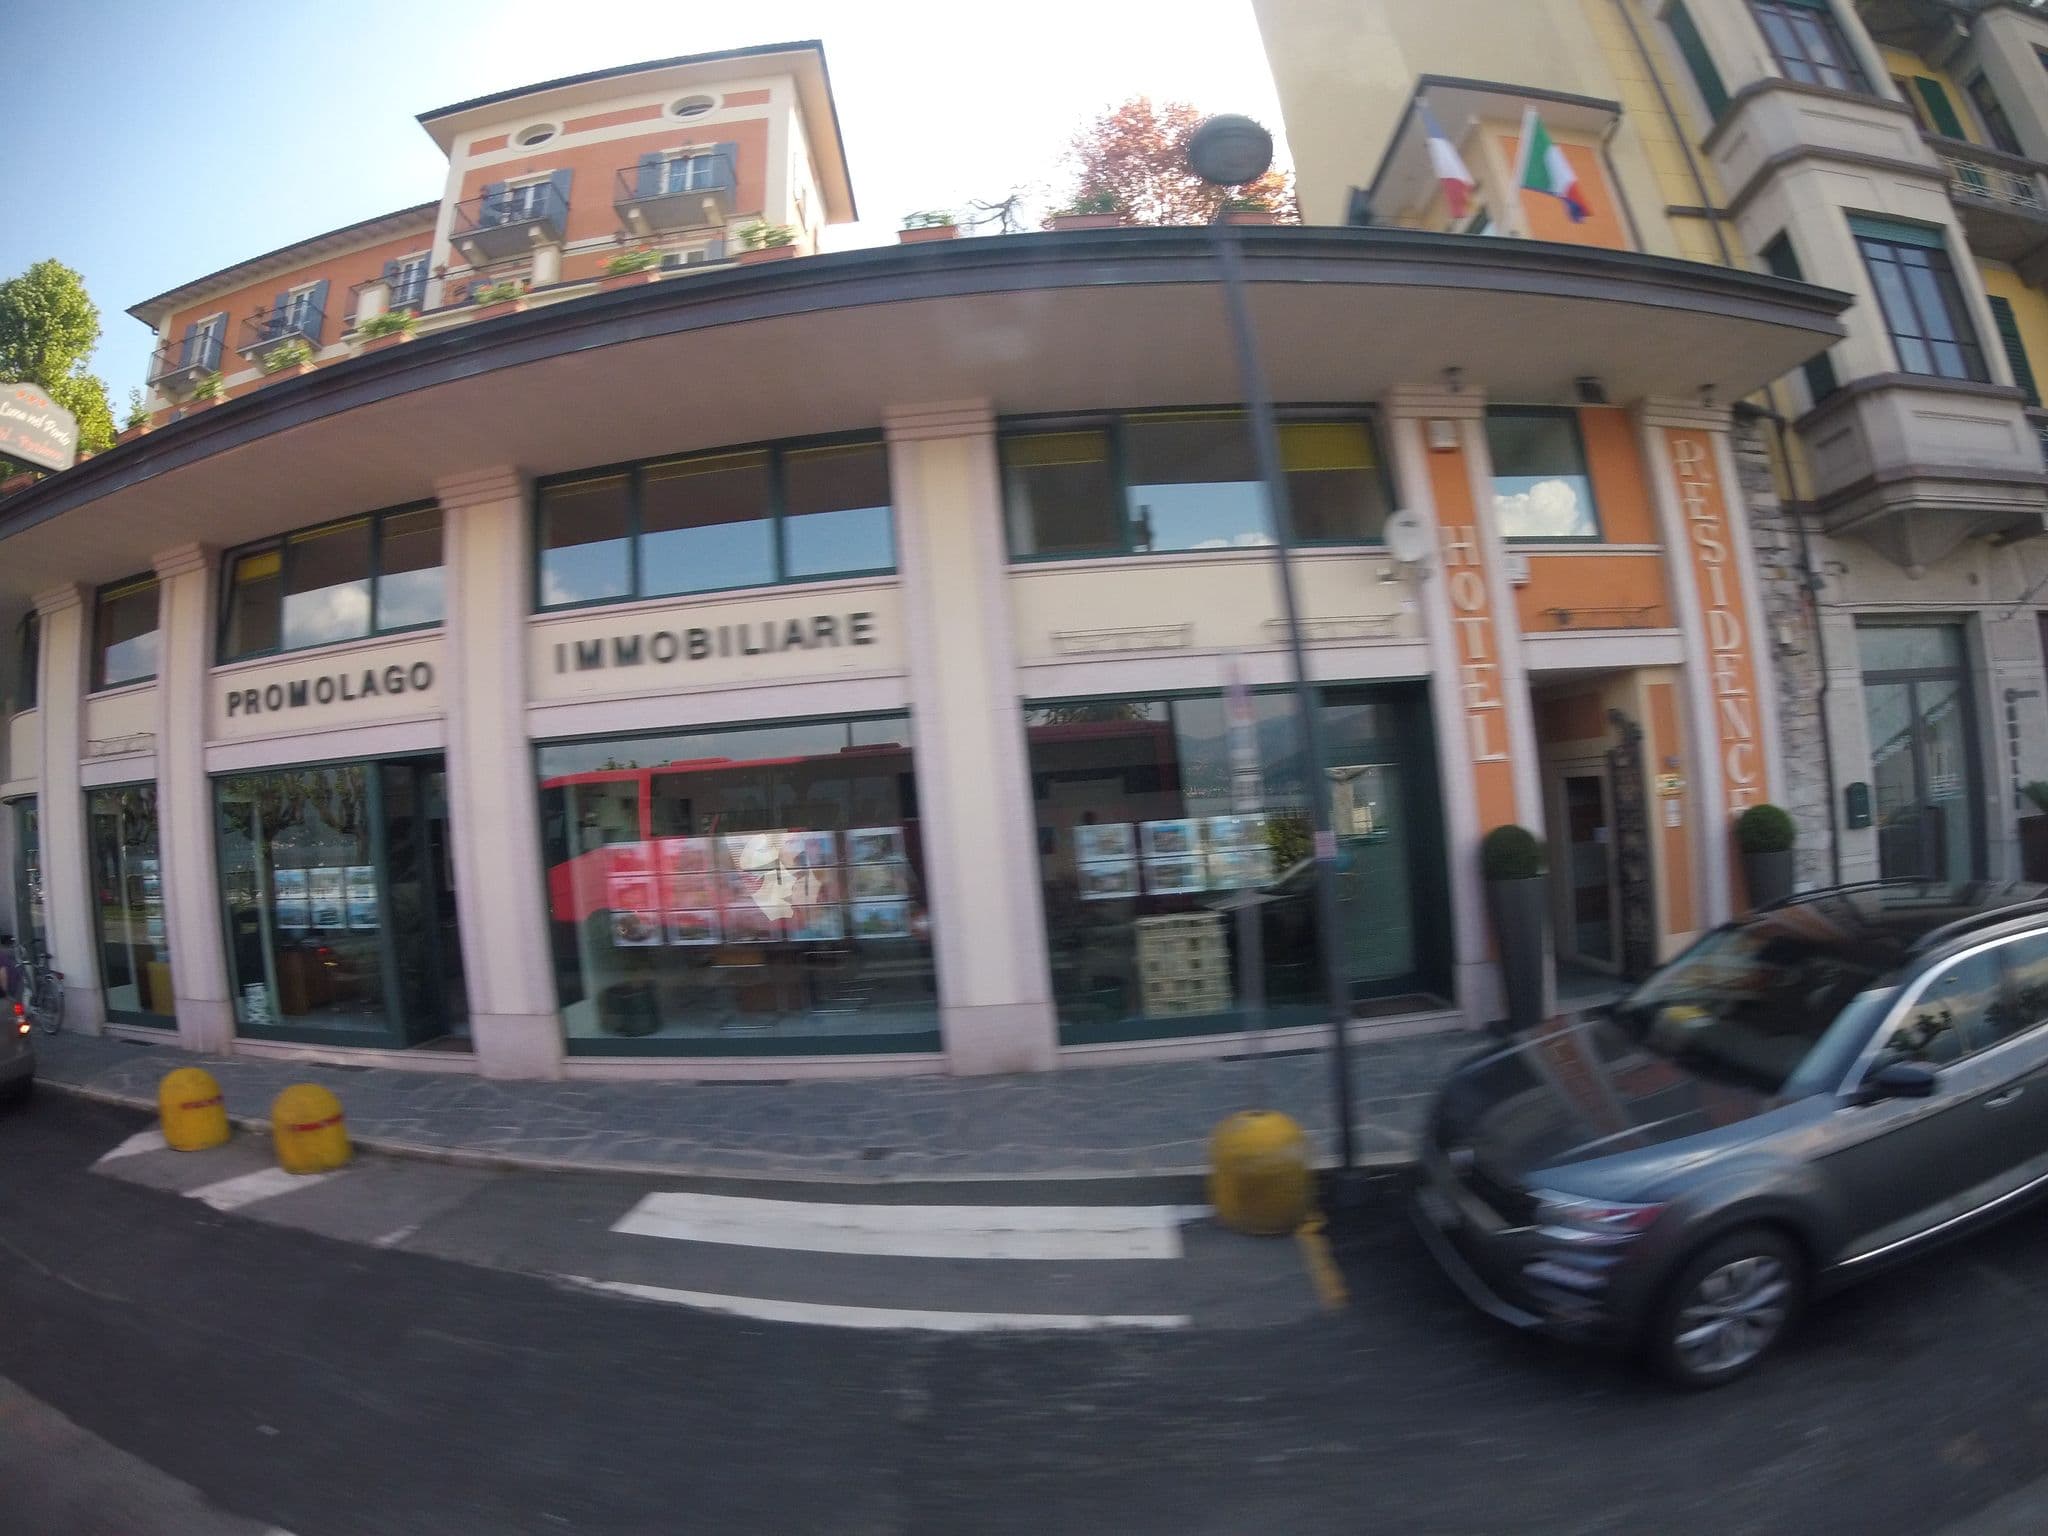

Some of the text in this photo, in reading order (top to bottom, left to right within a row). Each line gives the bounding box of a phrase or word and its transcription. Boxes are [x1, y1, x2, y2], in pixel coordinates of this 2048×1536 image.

[226, 611, 876, 717] PROMOLAGO IMMOBILIARE
[1442, 526, 1512, 761] HOTEL
